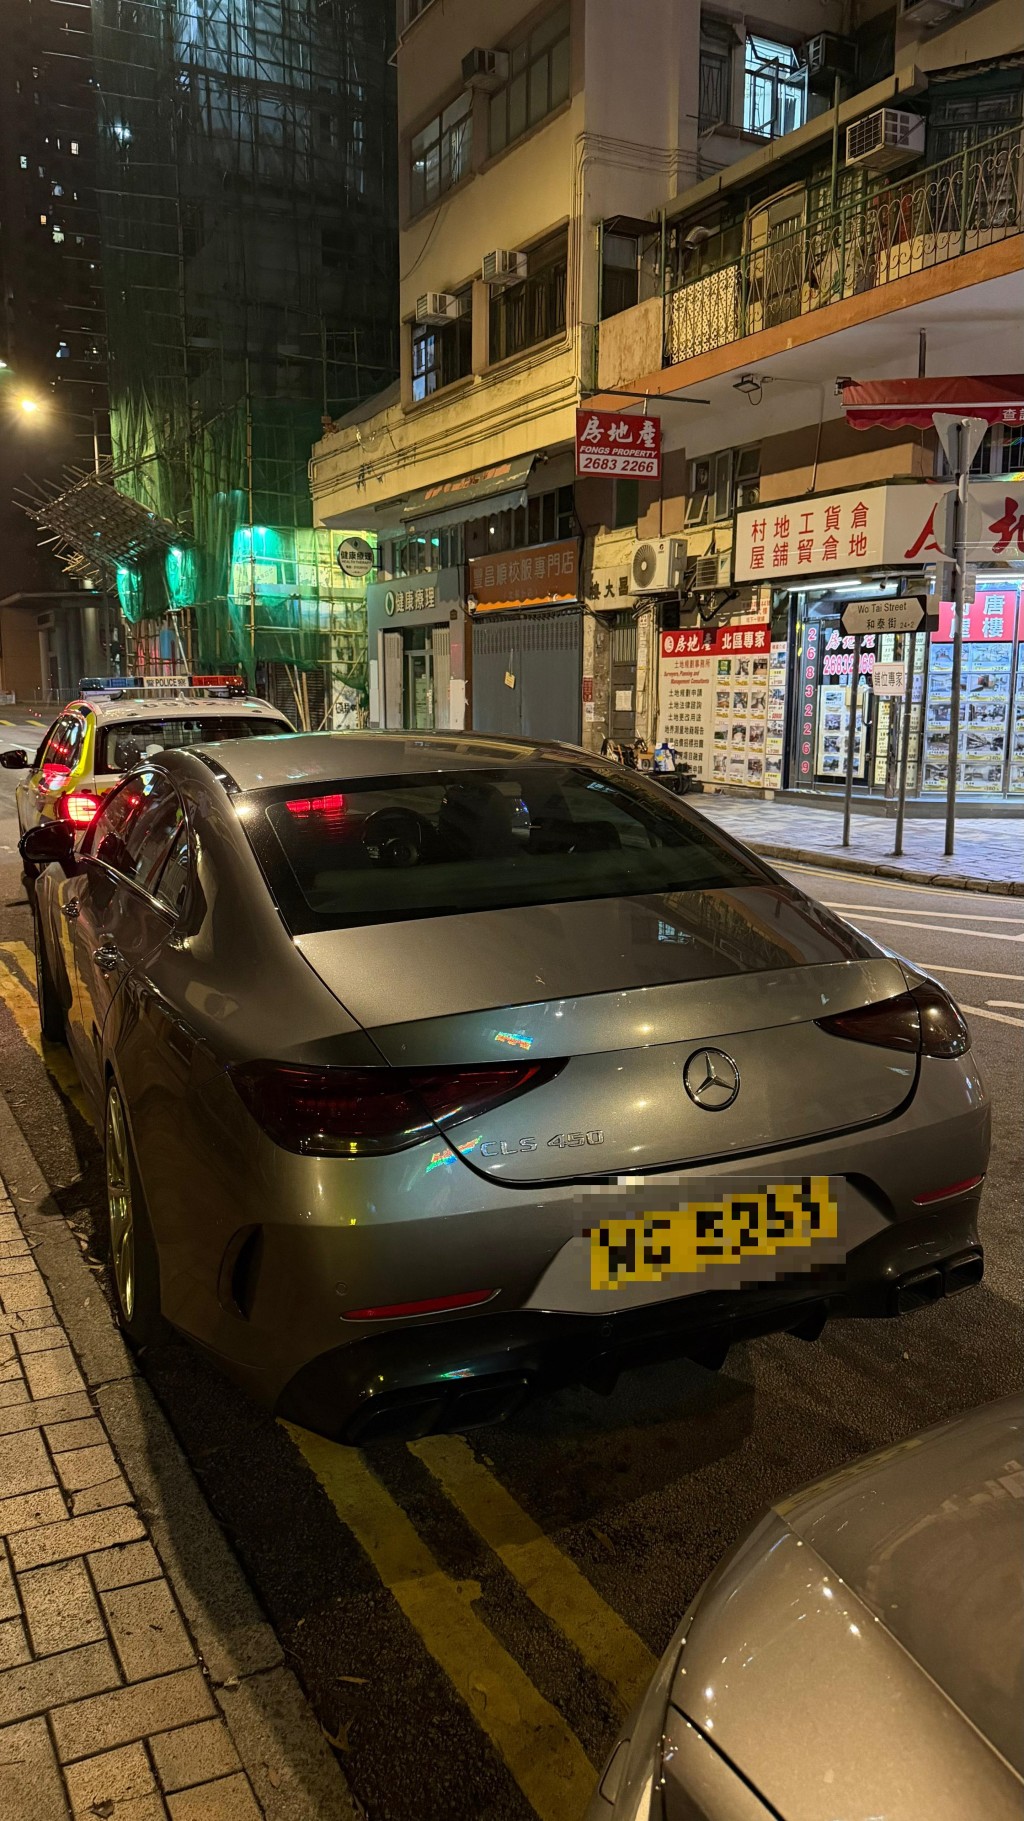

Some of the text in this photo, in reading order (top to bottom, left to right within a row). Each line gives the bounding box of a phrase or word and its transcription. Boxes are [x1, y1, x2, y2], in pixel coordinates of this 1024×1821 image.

[580, 415, 656, 448] 房地產
[580, 445, 657, 458] FONGS PROPERTY
[583, 457, 654, 473] 2683 2266
[340, 550, 373, 561] 健康療理
[395, 586, 436, 614] 健康療理
[857, 601, 907, 614] Wo Tai Street
[866, 617, 897, 631] 和泰街
[982, 594, 1005, 638] 唐樓
[675, 633, 711, 654] 房地產
[721, 631, 766, 650] 北區專家
[823, 652, 876, 676] 2683269
[155, 678, 177, 687] POLICE
[480, 1129, 605, 1157] CLS 450
